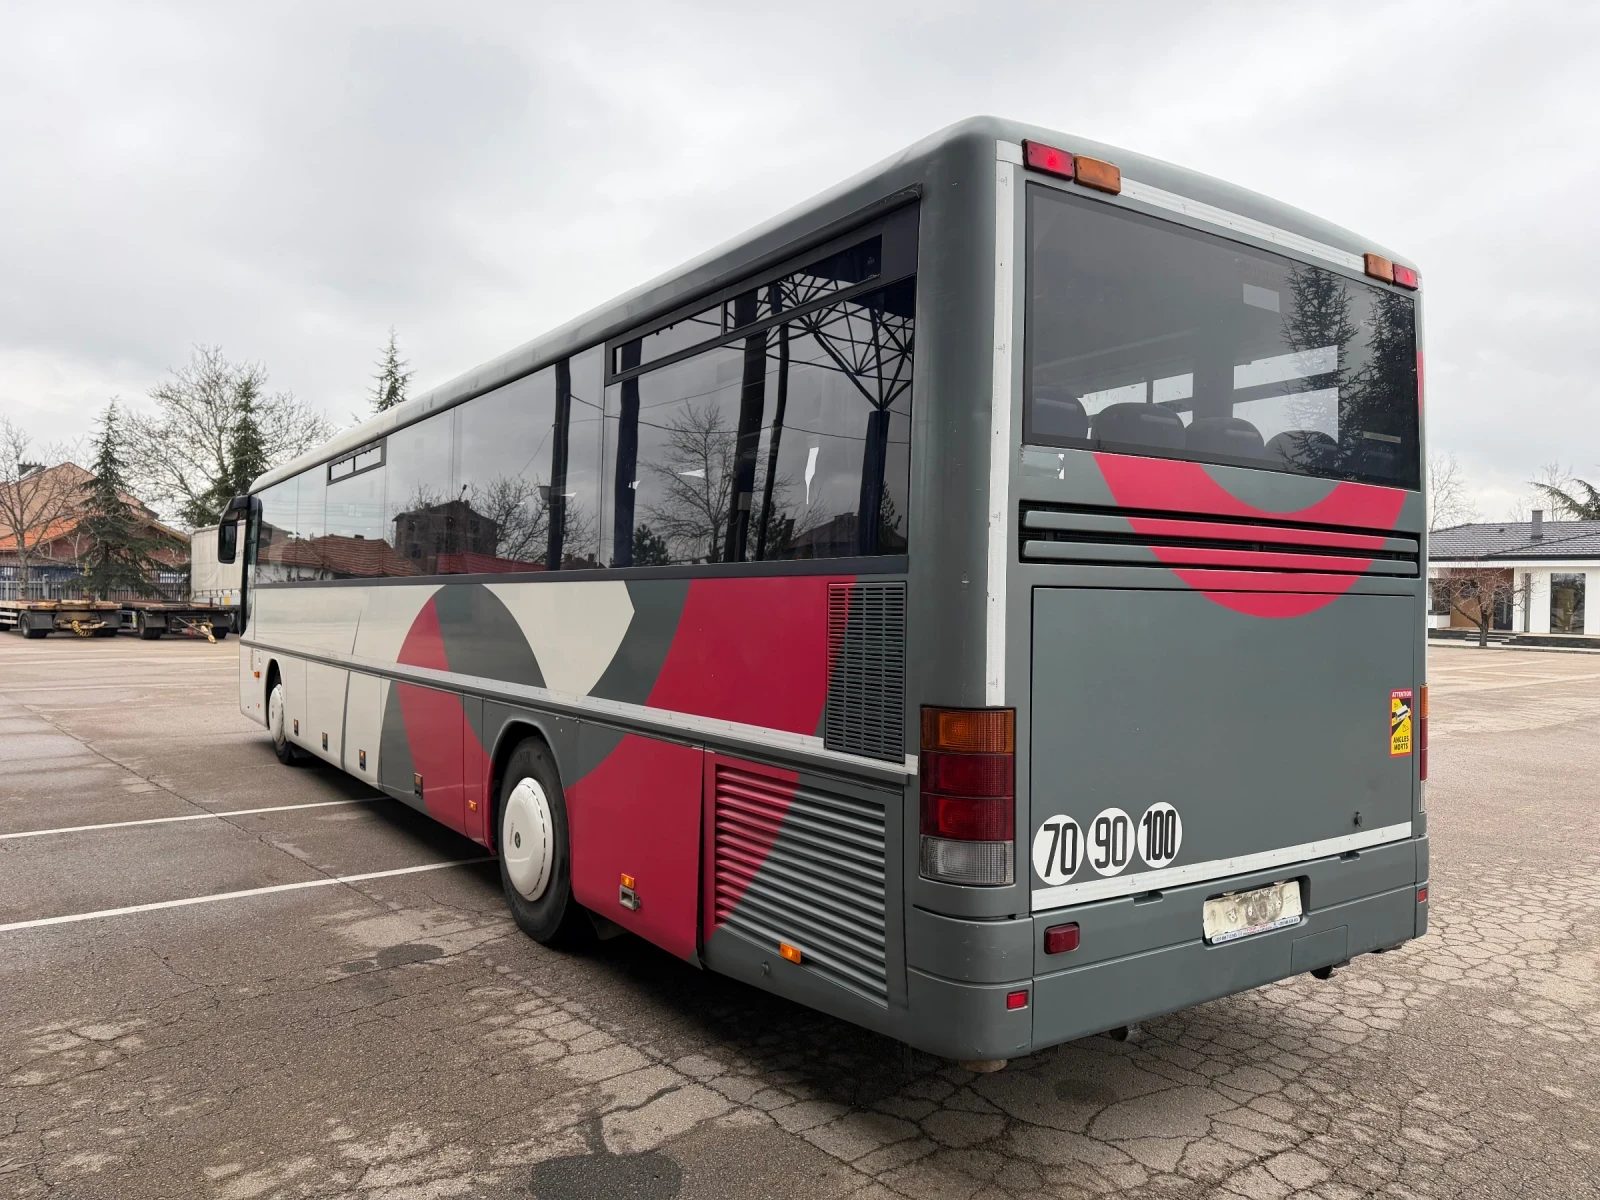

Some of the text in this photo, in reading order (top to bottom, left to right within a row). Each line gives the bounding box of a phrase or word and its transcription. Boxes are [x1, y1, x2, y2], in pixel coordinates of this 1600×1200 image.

[1043, 822, 1078, 877] 70
[1094, 816, 1128, 869] 90
[1143, 809, 1177, 861] 100
